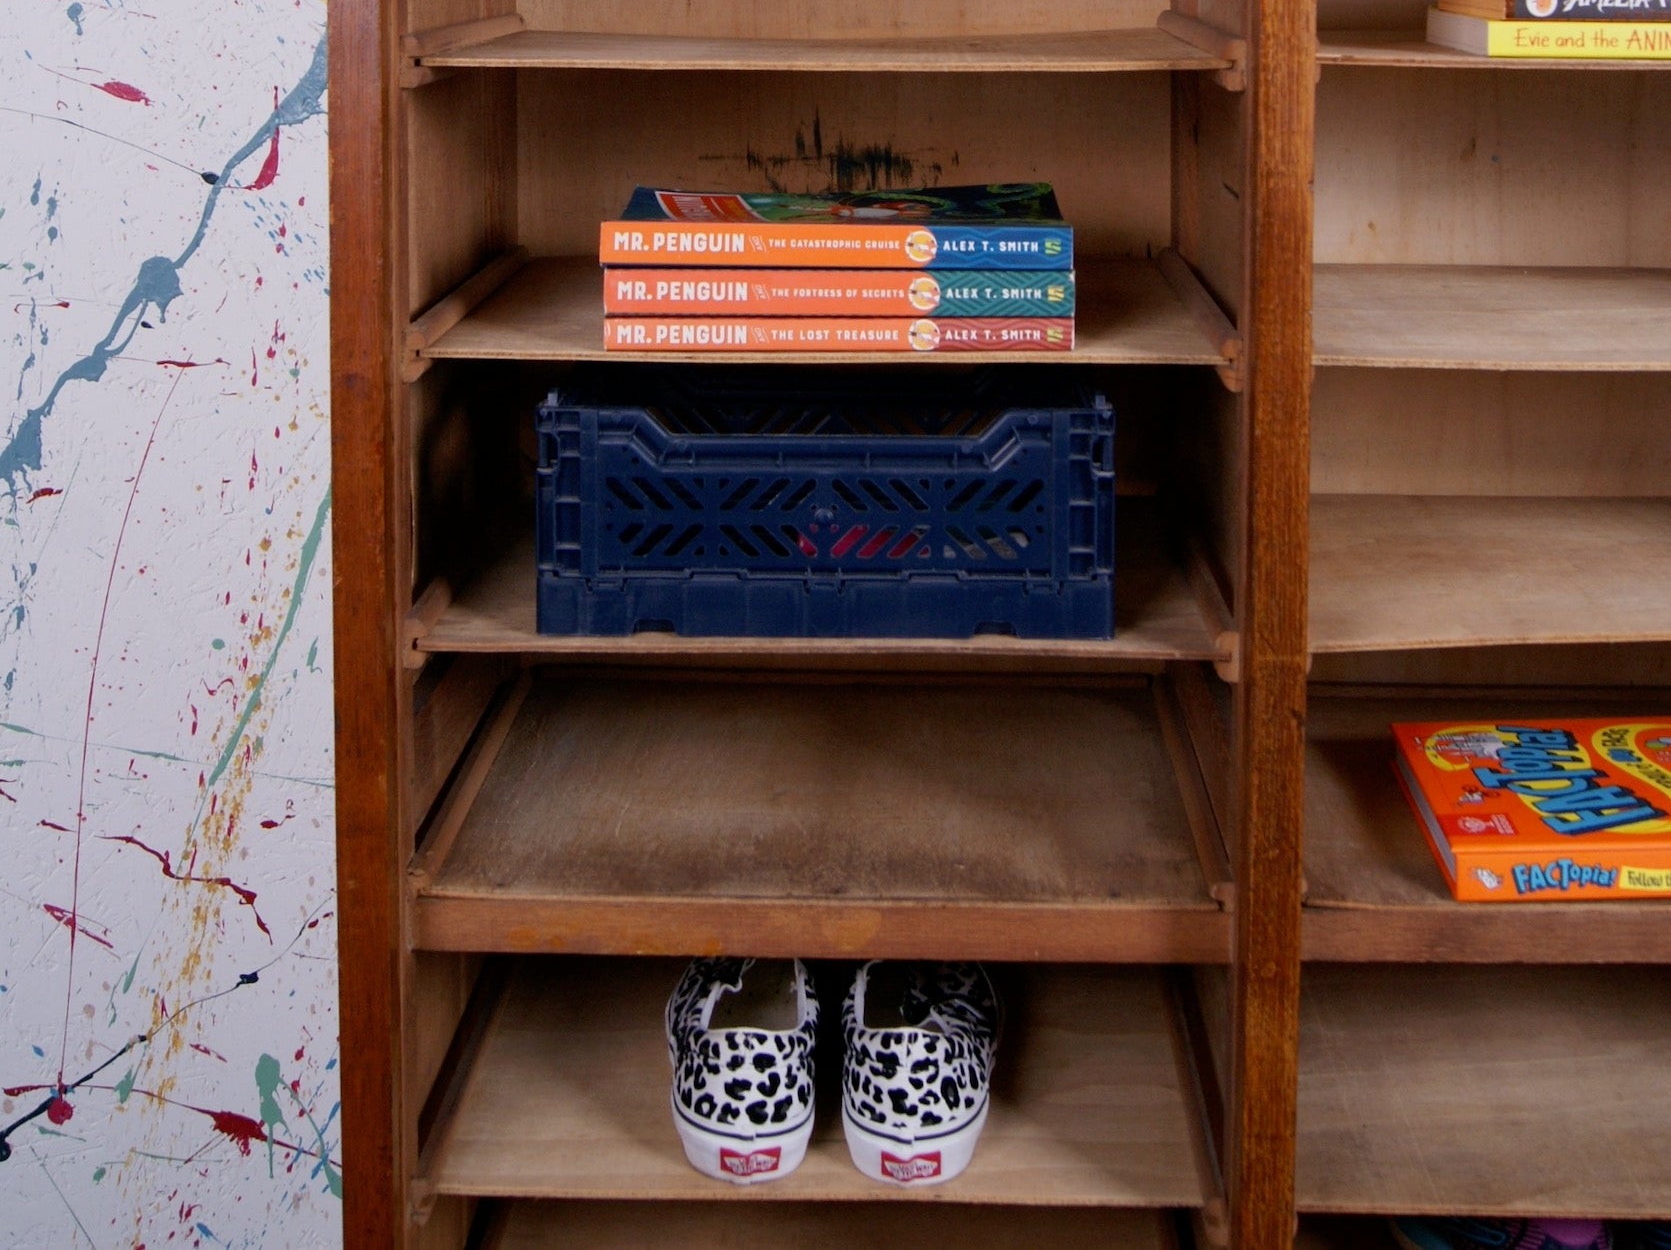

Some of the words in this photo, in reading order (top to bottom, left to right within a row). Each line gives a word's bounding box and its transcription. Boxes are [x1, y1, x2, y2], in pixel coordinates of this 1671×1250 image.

[1514, 27, 1549, 48] Evie
[1555, 31, 1585, 48] and
[1591, 27, 1619, 48] the
[613, 231, 650, 252] MR.
[653, 232, 745, 253] PENGUIN
[768, 238, 786, 248] THE
[790, 239, 862, 249] CATASTROPHIC
[865, 240, 900, 250] CRUISE
[943, 240, 976, 252] ALEX
[982, 241, 995, 252] T.
[999, 241, 1039, 253] SMITH
[616, 281, 653, 301] MR.
[656, 281, 748, 301] PENGUIN
[771, 288, 790, 297] THE
[793, 288, 842, 297] FORTRESS
[846, 288, 858, 297] OF
[862, 288, 905, 298] SECRETS
[945, 288, 979, 299] ALEX
[985, 288, 998, 299] T.
[1002, 288, 1042, 299] SMITH
[616, 324, 653, 344] MR.
[656, 325, 748, 345] PENGUIN
[771, 329, 794, 341] THE
[800, 329, 830, 340] LOST
[836, 330, 899, 340] TREASURE
[945, 330, 978, 341] ALEX
[984, 330, 997, 341] T.
[1001, 330, 1041, 341] SMITH
